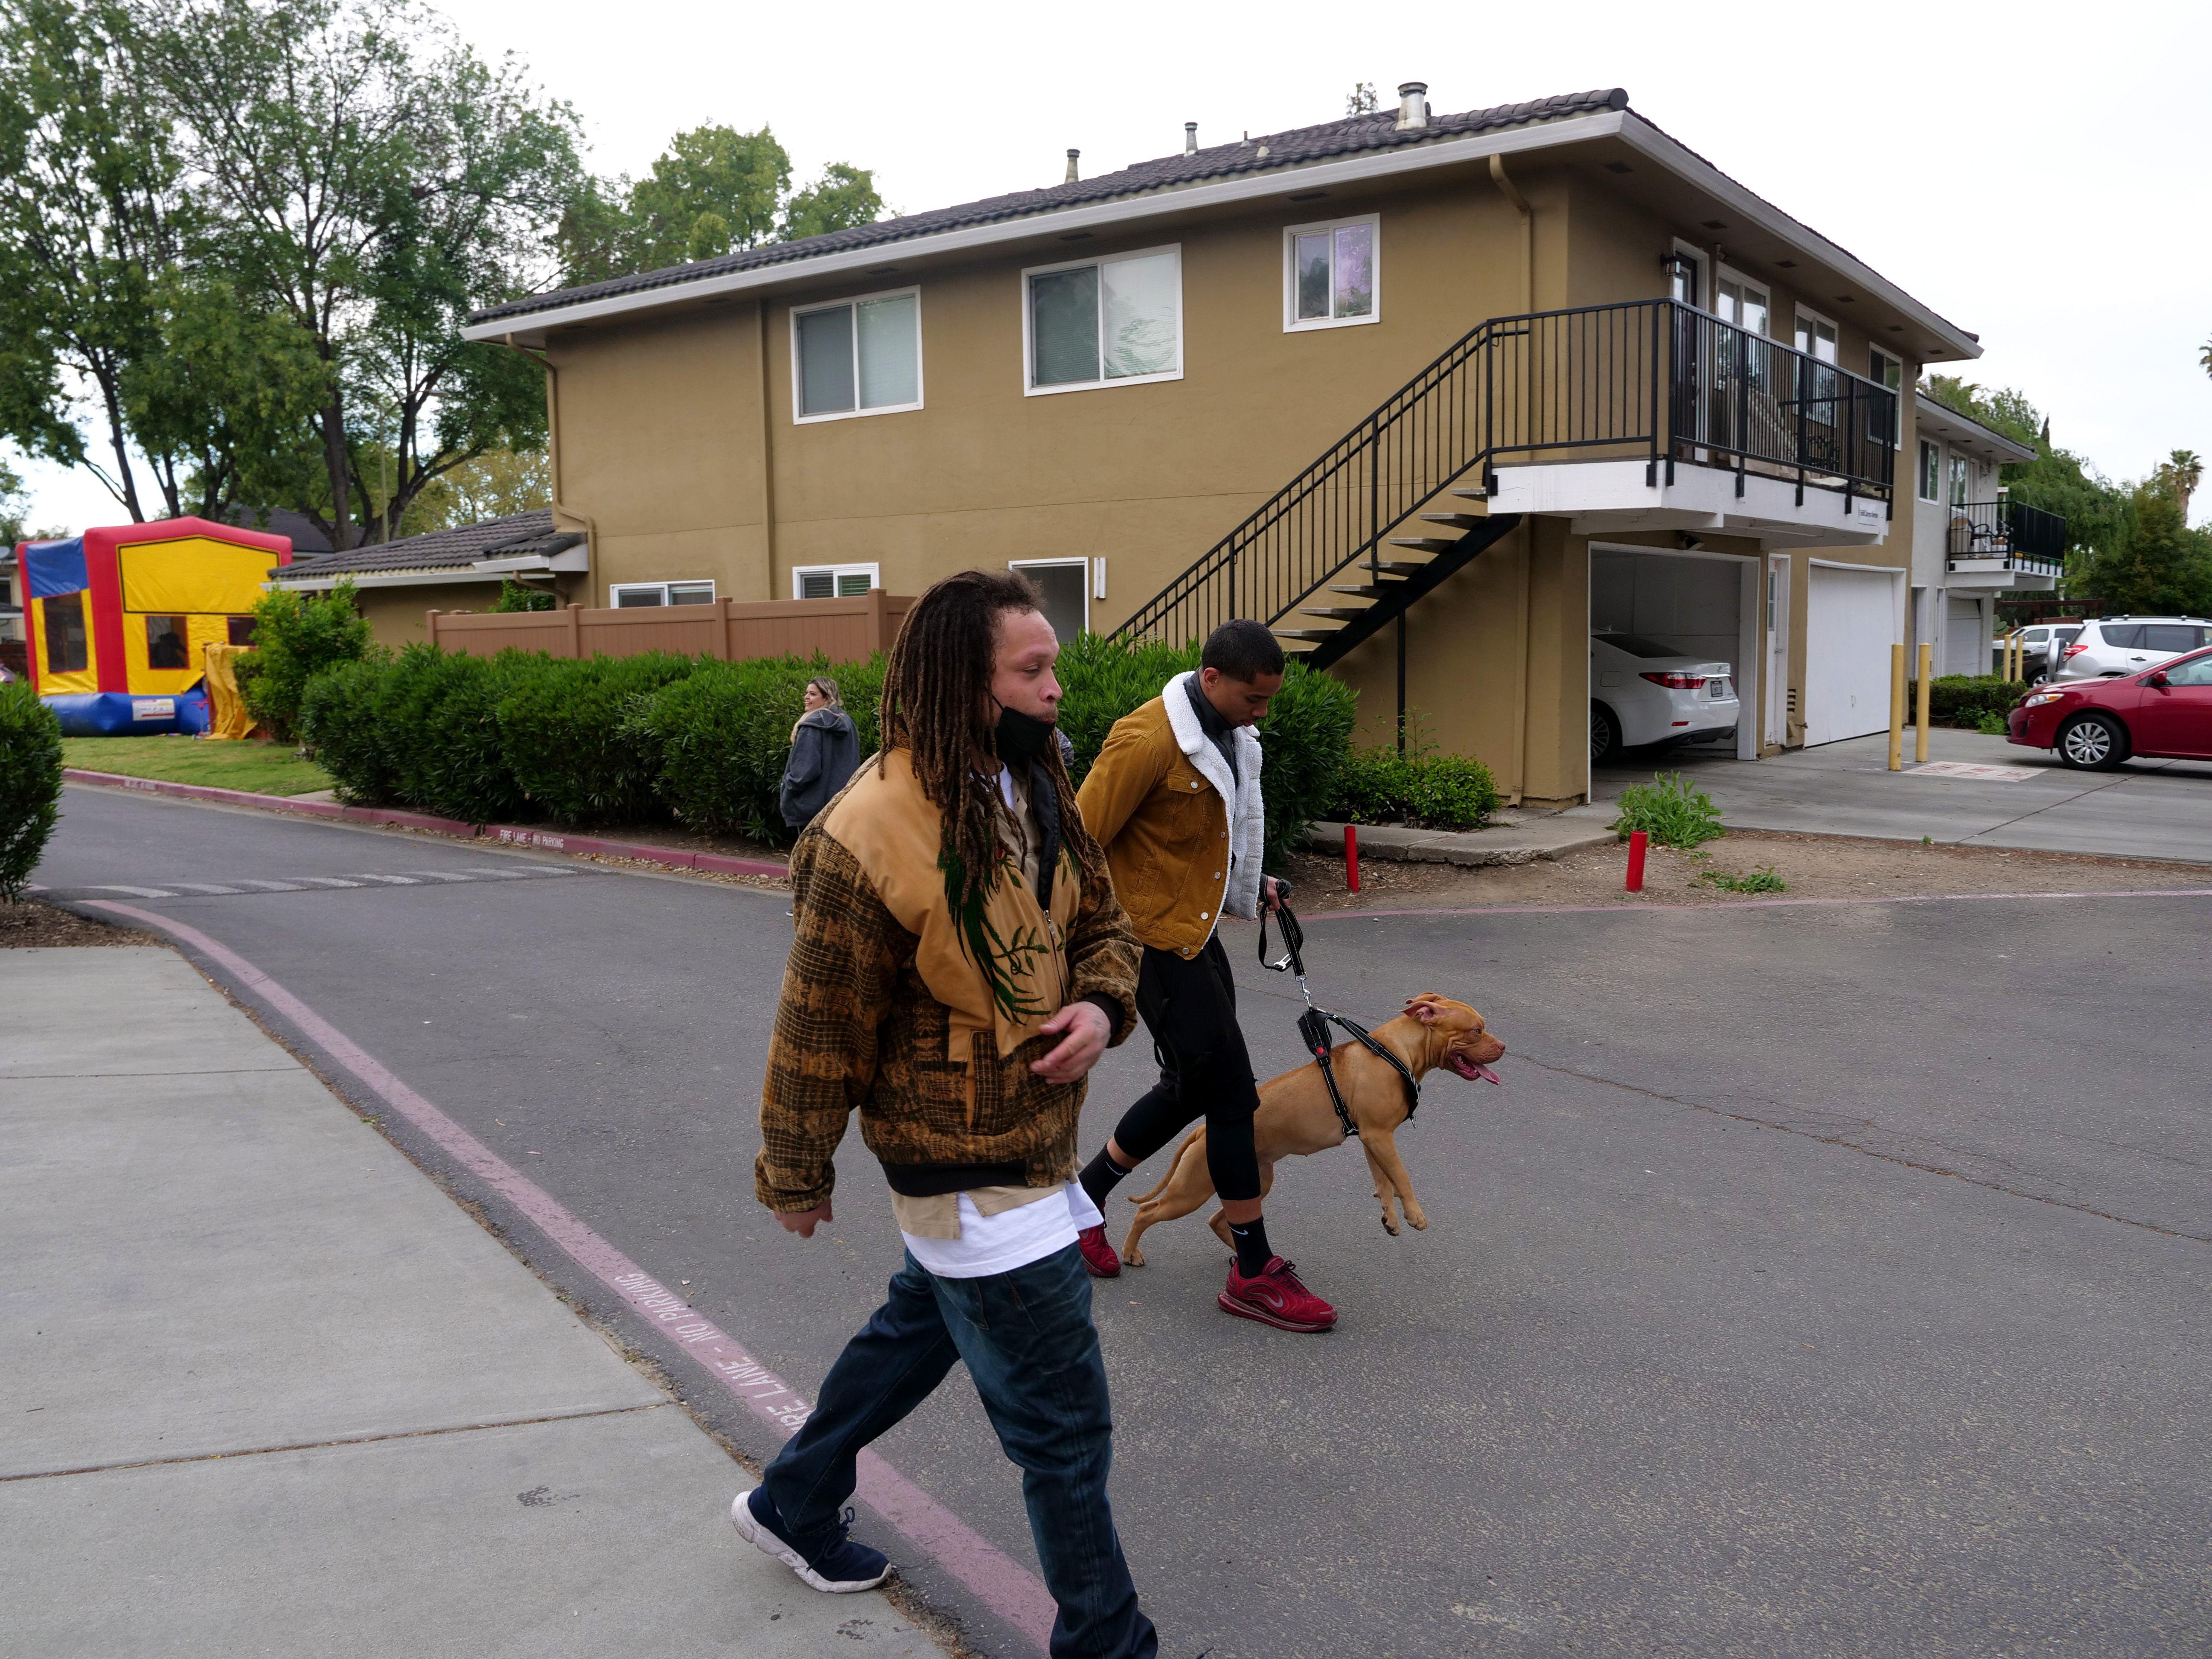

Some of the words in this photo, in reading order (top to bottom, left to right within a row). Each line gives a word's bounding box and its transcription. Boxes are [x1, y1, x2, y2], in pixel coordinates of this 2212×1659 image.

[500, 830, 512, 841] FIRE
[513, 832, 527, 843] LANE
[533, 834, 541, 845] NO
[542, 835, 564, 848] PARKING
[614, 1273, 695, 1321] PARKING
[675, 1323, 722, 1343] NO
[714, 1356, 788, 1398] LANE
